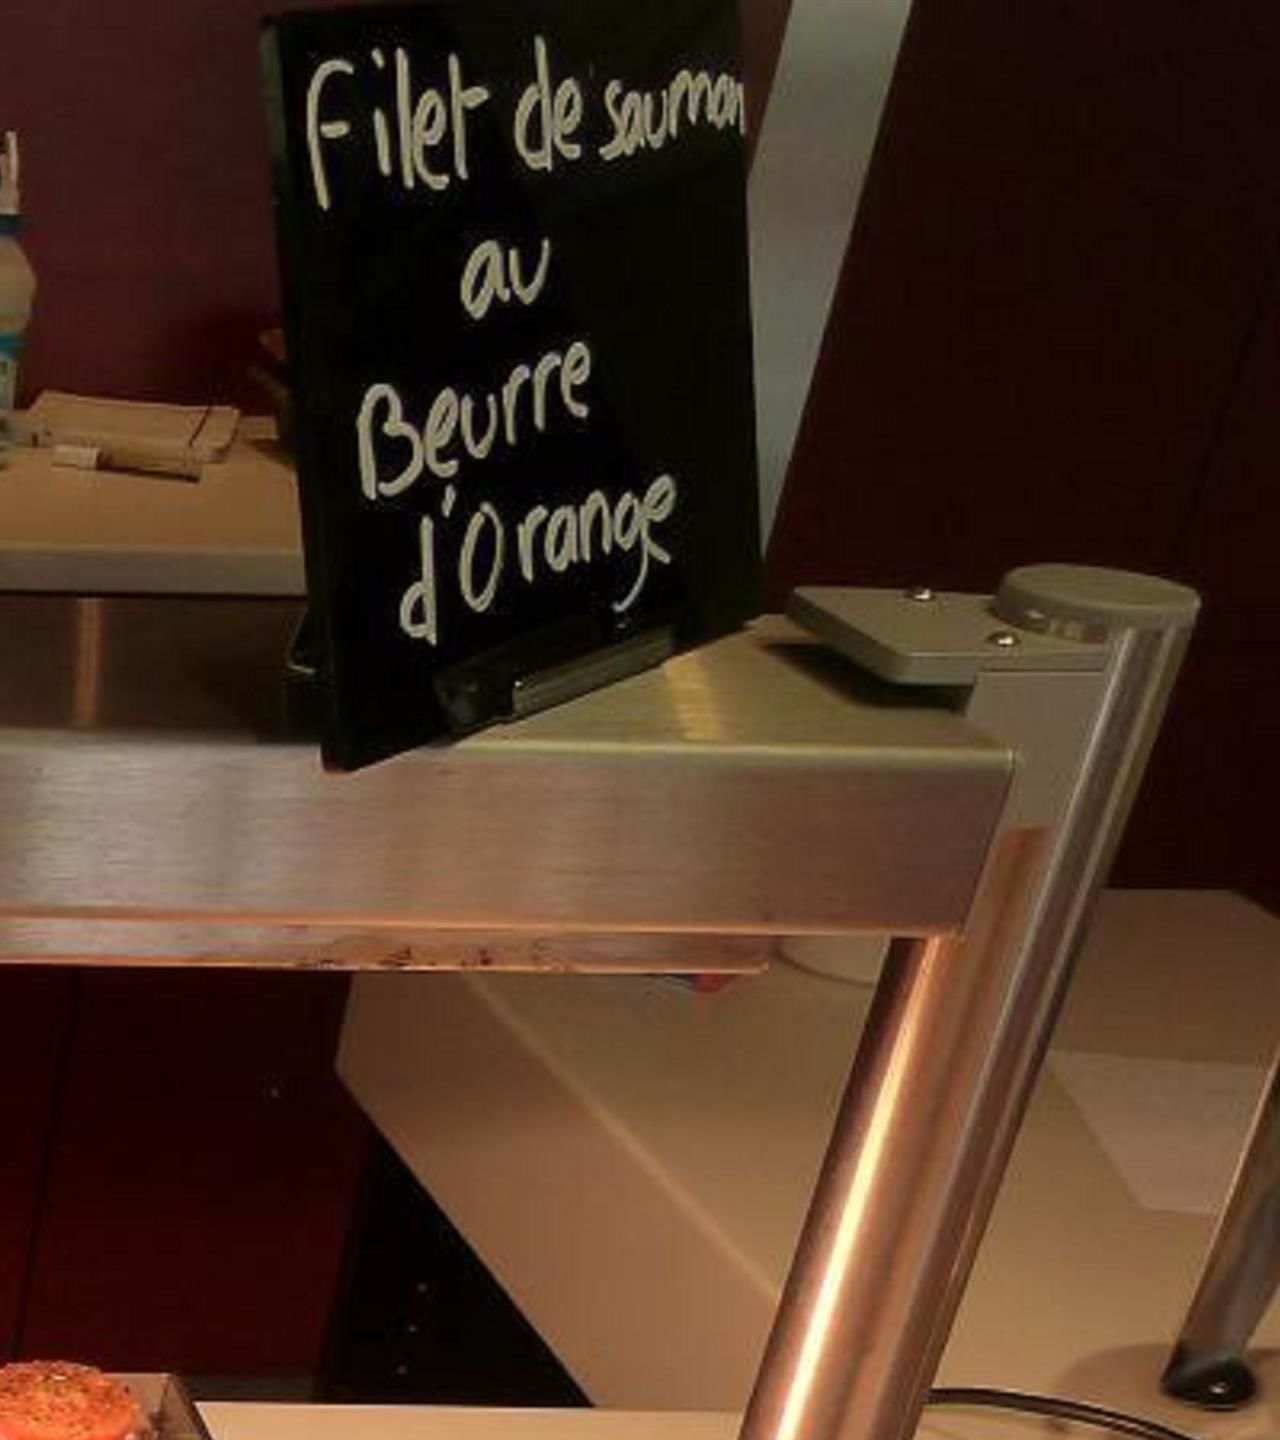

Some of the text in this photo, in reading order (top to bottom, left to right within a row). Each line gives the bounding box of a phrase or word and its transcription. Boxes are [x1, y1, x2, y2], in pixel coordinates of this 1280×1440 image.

[514, 35, 583, 172] de
[460, 236, 549, 320] au
[357, 340, 591, 500] Beurre
[399, 473, 677, 646] d'Orange
